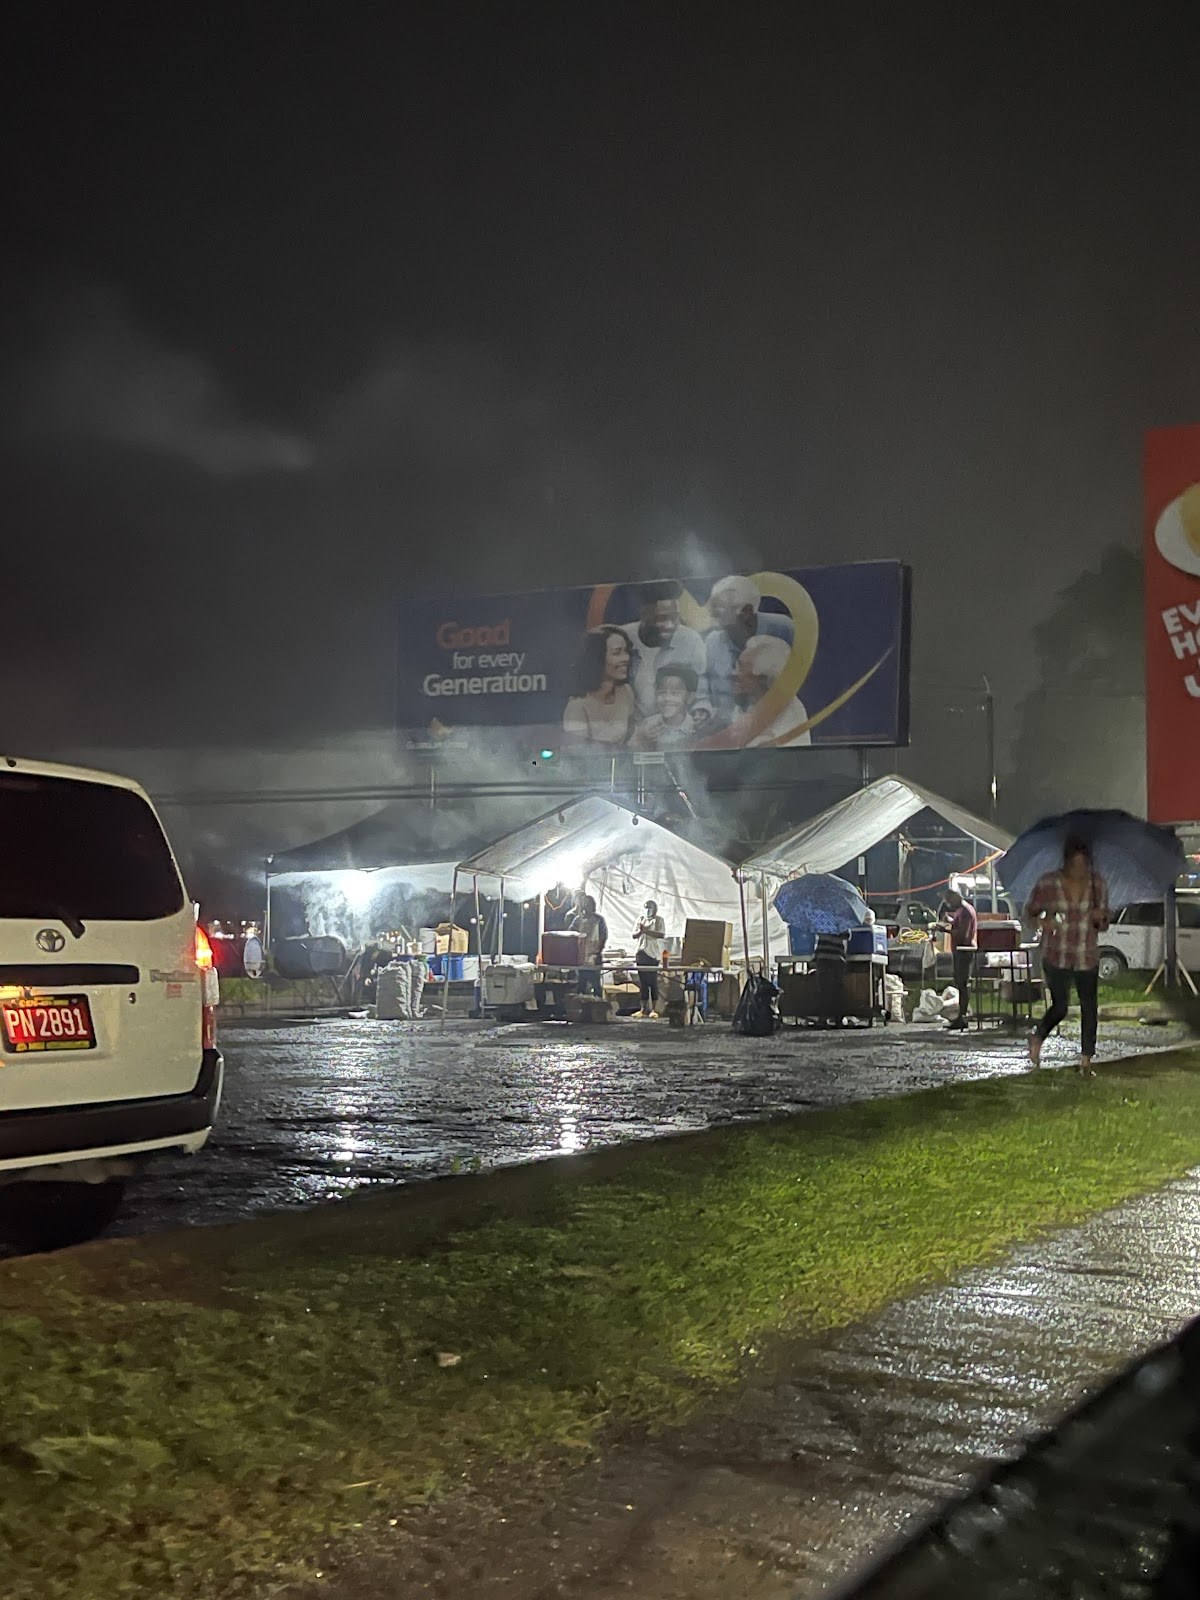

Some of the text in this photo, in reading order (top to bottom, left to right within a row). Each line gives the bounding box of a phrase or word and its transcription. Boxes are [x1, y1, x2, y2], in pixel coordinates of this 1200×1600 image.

[437, 618, 511, 648] Good
[452, 651, 526, 675] for every
[422, 671, 548, 697] Generation
[7, 1008, 87, 1038] PN 2891
